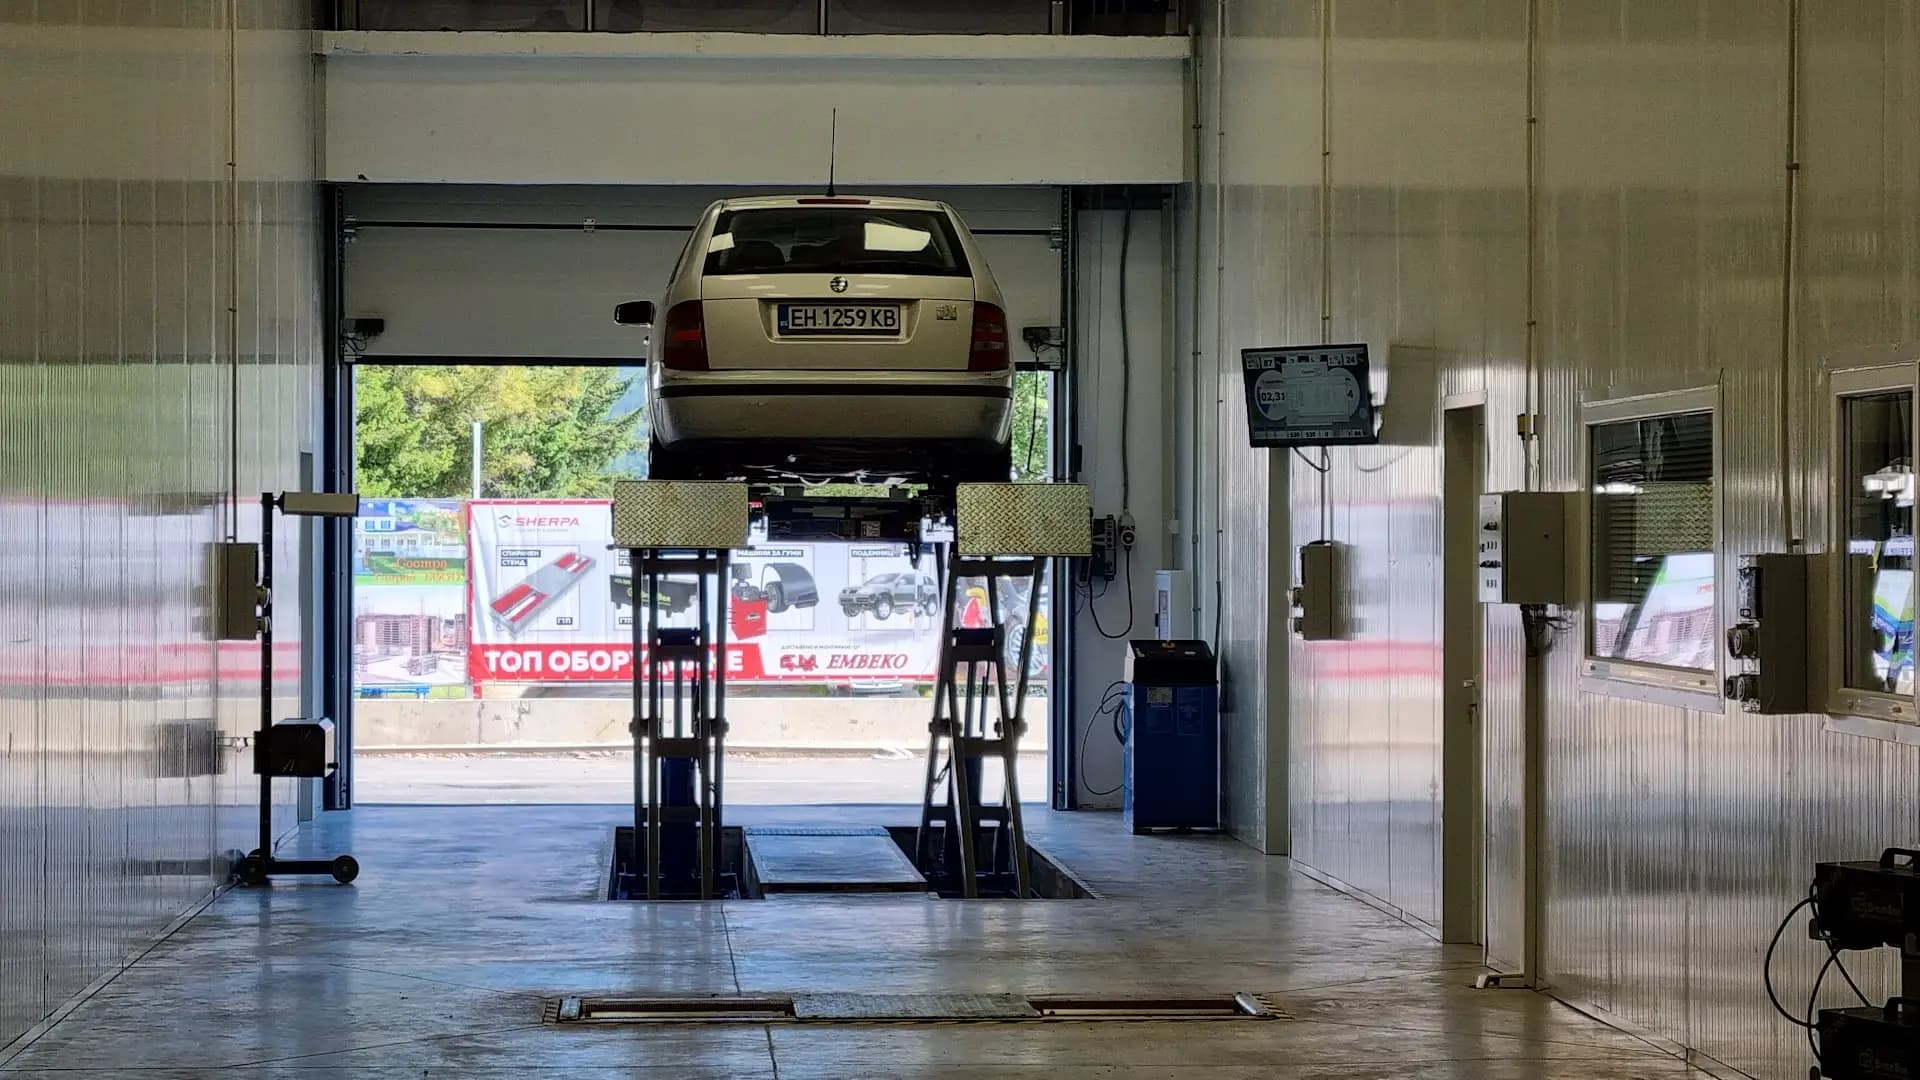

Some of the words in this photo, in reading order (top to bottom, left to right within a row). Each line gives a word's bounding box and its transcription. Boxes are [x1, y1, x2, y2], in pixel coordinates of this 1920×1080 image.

[791, 309, 816, 326] EH
[823, 309, 866, 326] 1259
[871, 309, 895, 327] KB
[515, 517, 580, 527] SHERPA
[485, 651, 542, 672] ТОП
[549, 650, 743, 675] ОБОРУЕ
[827, 654, 908, 669] EMBEKO
